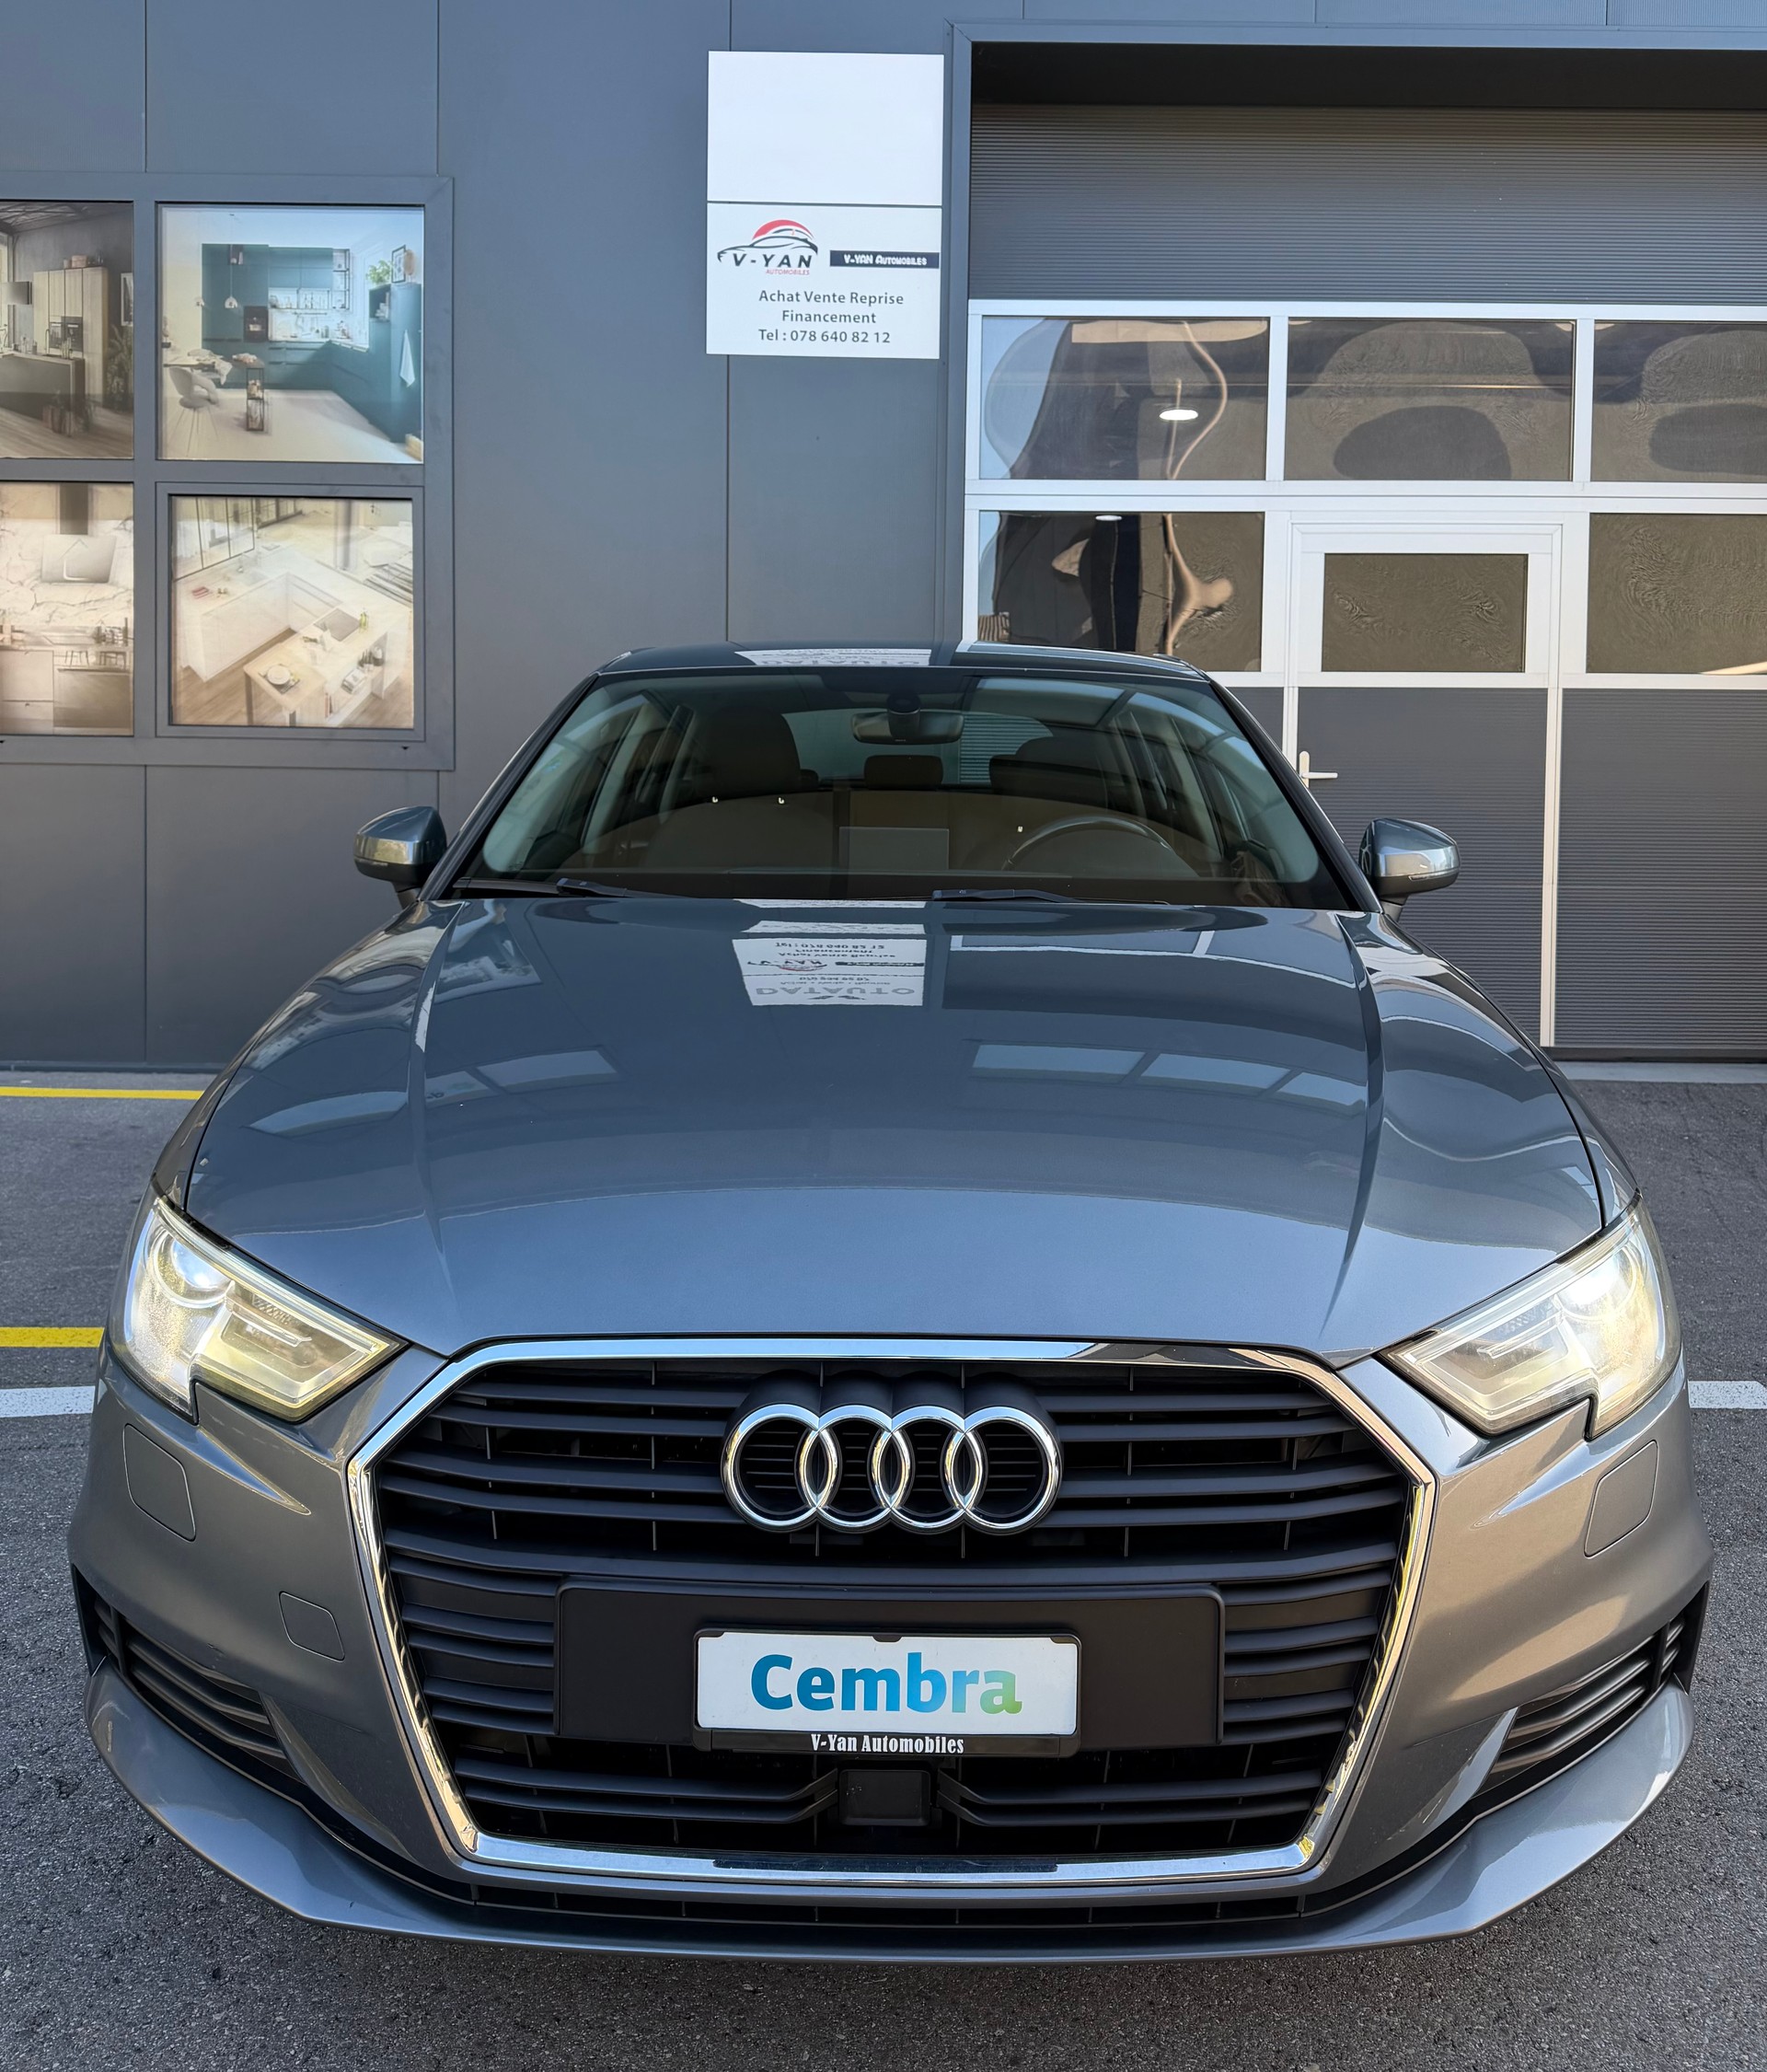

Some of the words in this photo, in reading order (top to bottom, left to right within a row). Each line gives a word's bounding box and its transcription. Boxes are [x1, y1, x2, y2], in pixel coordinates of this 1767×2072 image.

[733, 253, 812, 268] V-YAN
[844, 254, 873, 264] V-YAN
[758, 290, 801, 303] Achat
[803, 291, 846, 304] Vente
[850, 292, 904, 307] Reprise
[782, 310, 876, 323] Financement
[758, 329, 779, 341] Tel
[791, 330, 816, 341] 078
[821, 330, 848, 342] 640
[851, 331, 869, 343] 82
[874, 332, 891, 343] 12
[750, 1651, 1022, 1715] Cembra
[811, 1733, 858, 1753] V-Yan
[861, 1734, 964, 1754] Automobiles
